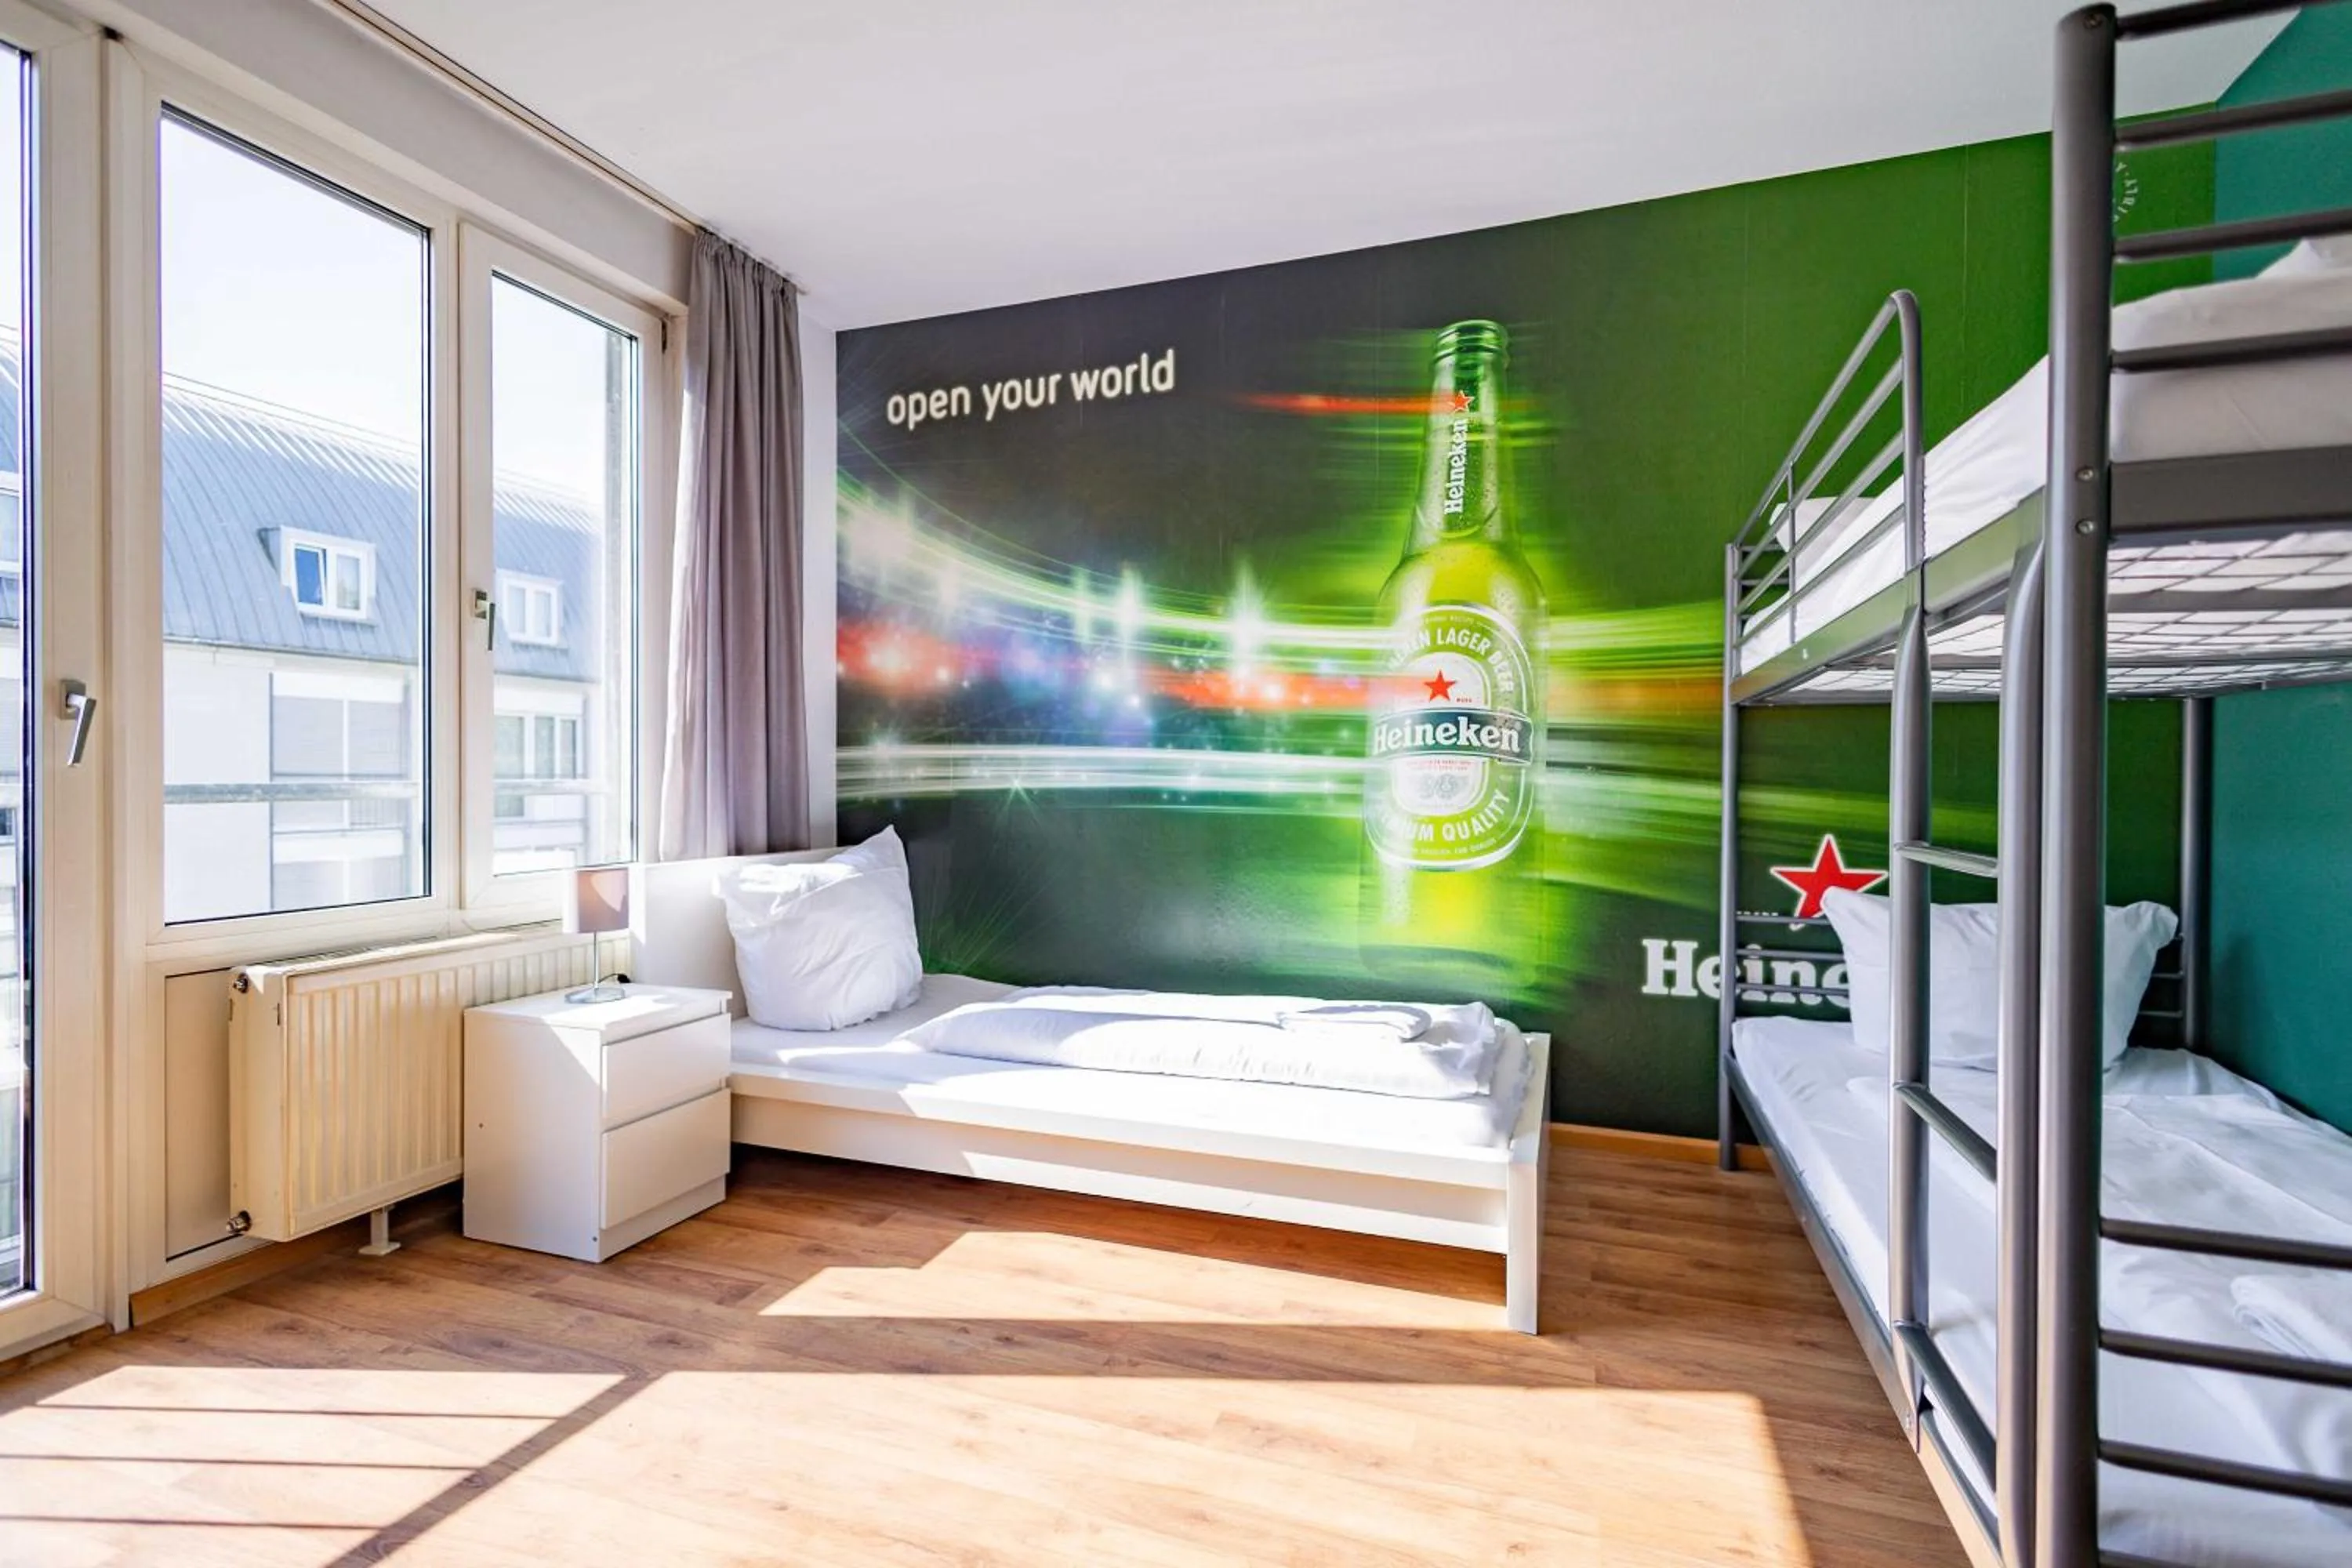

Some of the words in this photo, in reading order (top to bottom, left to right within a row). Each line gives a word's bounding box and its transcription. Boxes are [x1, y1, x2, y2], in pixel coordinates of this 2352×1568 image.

[887, 387, 971, 430] open
[982, 372, 1062, 422] your
[1070, 348, 1175, 402] world
[1443, 418, 1469, 515] Heineken
[1436, 626, 1491, 656] LAGER
[1487, 650, 1515, 694] BEER
[1373, 716, 1521, 756] Heineken
[1441, 788, 1511, 842] QUALITY
[1641, 938, 1850, 1009] Heine
